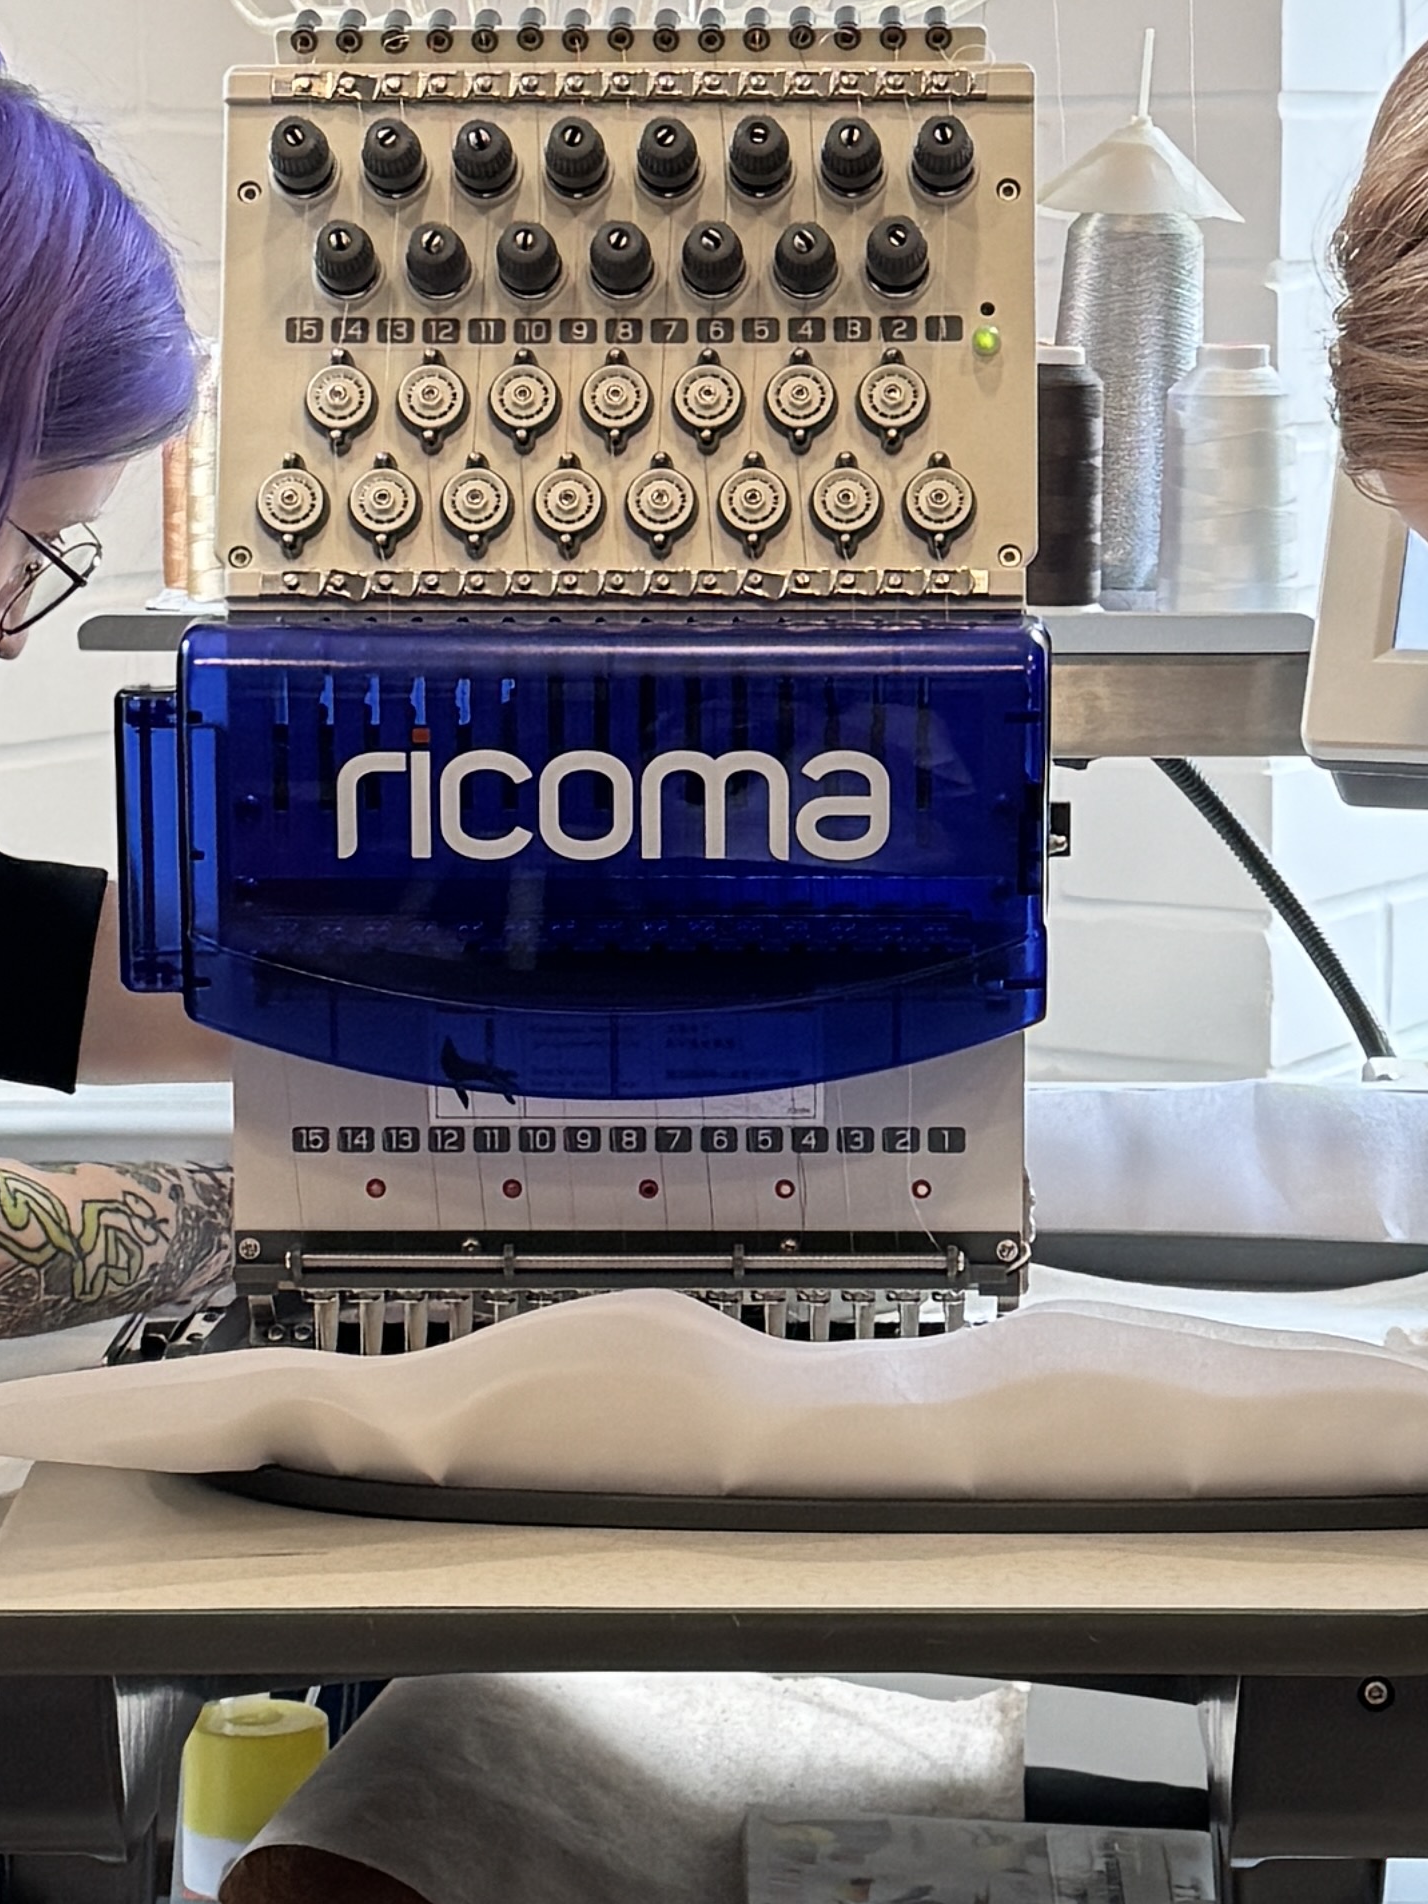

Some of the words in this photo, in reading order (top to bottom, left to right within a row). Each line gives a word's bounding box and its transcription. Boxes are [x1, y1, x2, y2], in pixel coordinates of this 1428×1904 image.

[294, 320, 317, 341] 15
[340, 320, 363, 341] 14
[385, 320, 408, 341] 13
[430, 320, 453, 341] 12
[479, 320, 494, 341] 11
[523, 320, 546, 341] 10
[572, 320, 588, 341] 9
[618, 320, 633, 341] 8
[663, 320, 678, 341] 7
[709, 320, 724, 341] 6
[754, 320, 769, 341] 5
[797, 320, 813, 341] 4
[847, 319, 862, 339] 3
[892, 319, 907, 339] 2
[336, 727, 891, 861] ricoma
[300, 1129, 323, 1150] 15
[344, 1129, 368, 1150] 14
[389, 1129, 412, 1150] 13
[435, 1129, 458, 1150] 12
[483, 1129, 499, 1150] 11
[526, 1129, 549, 1150] 10
[576, 1129, 592, 1150] 9
[622, 1129, 637, 1150] 8
[666, 1129, 681, 1150] 7
[713, 1129, 728, 1150] 6
[757, 1129, 772, 1150] 5
[801, 1129, 817, 1150] 4
[850, 1129, 864, 1150] 3
[895, 1129, 910, 1150] 2
